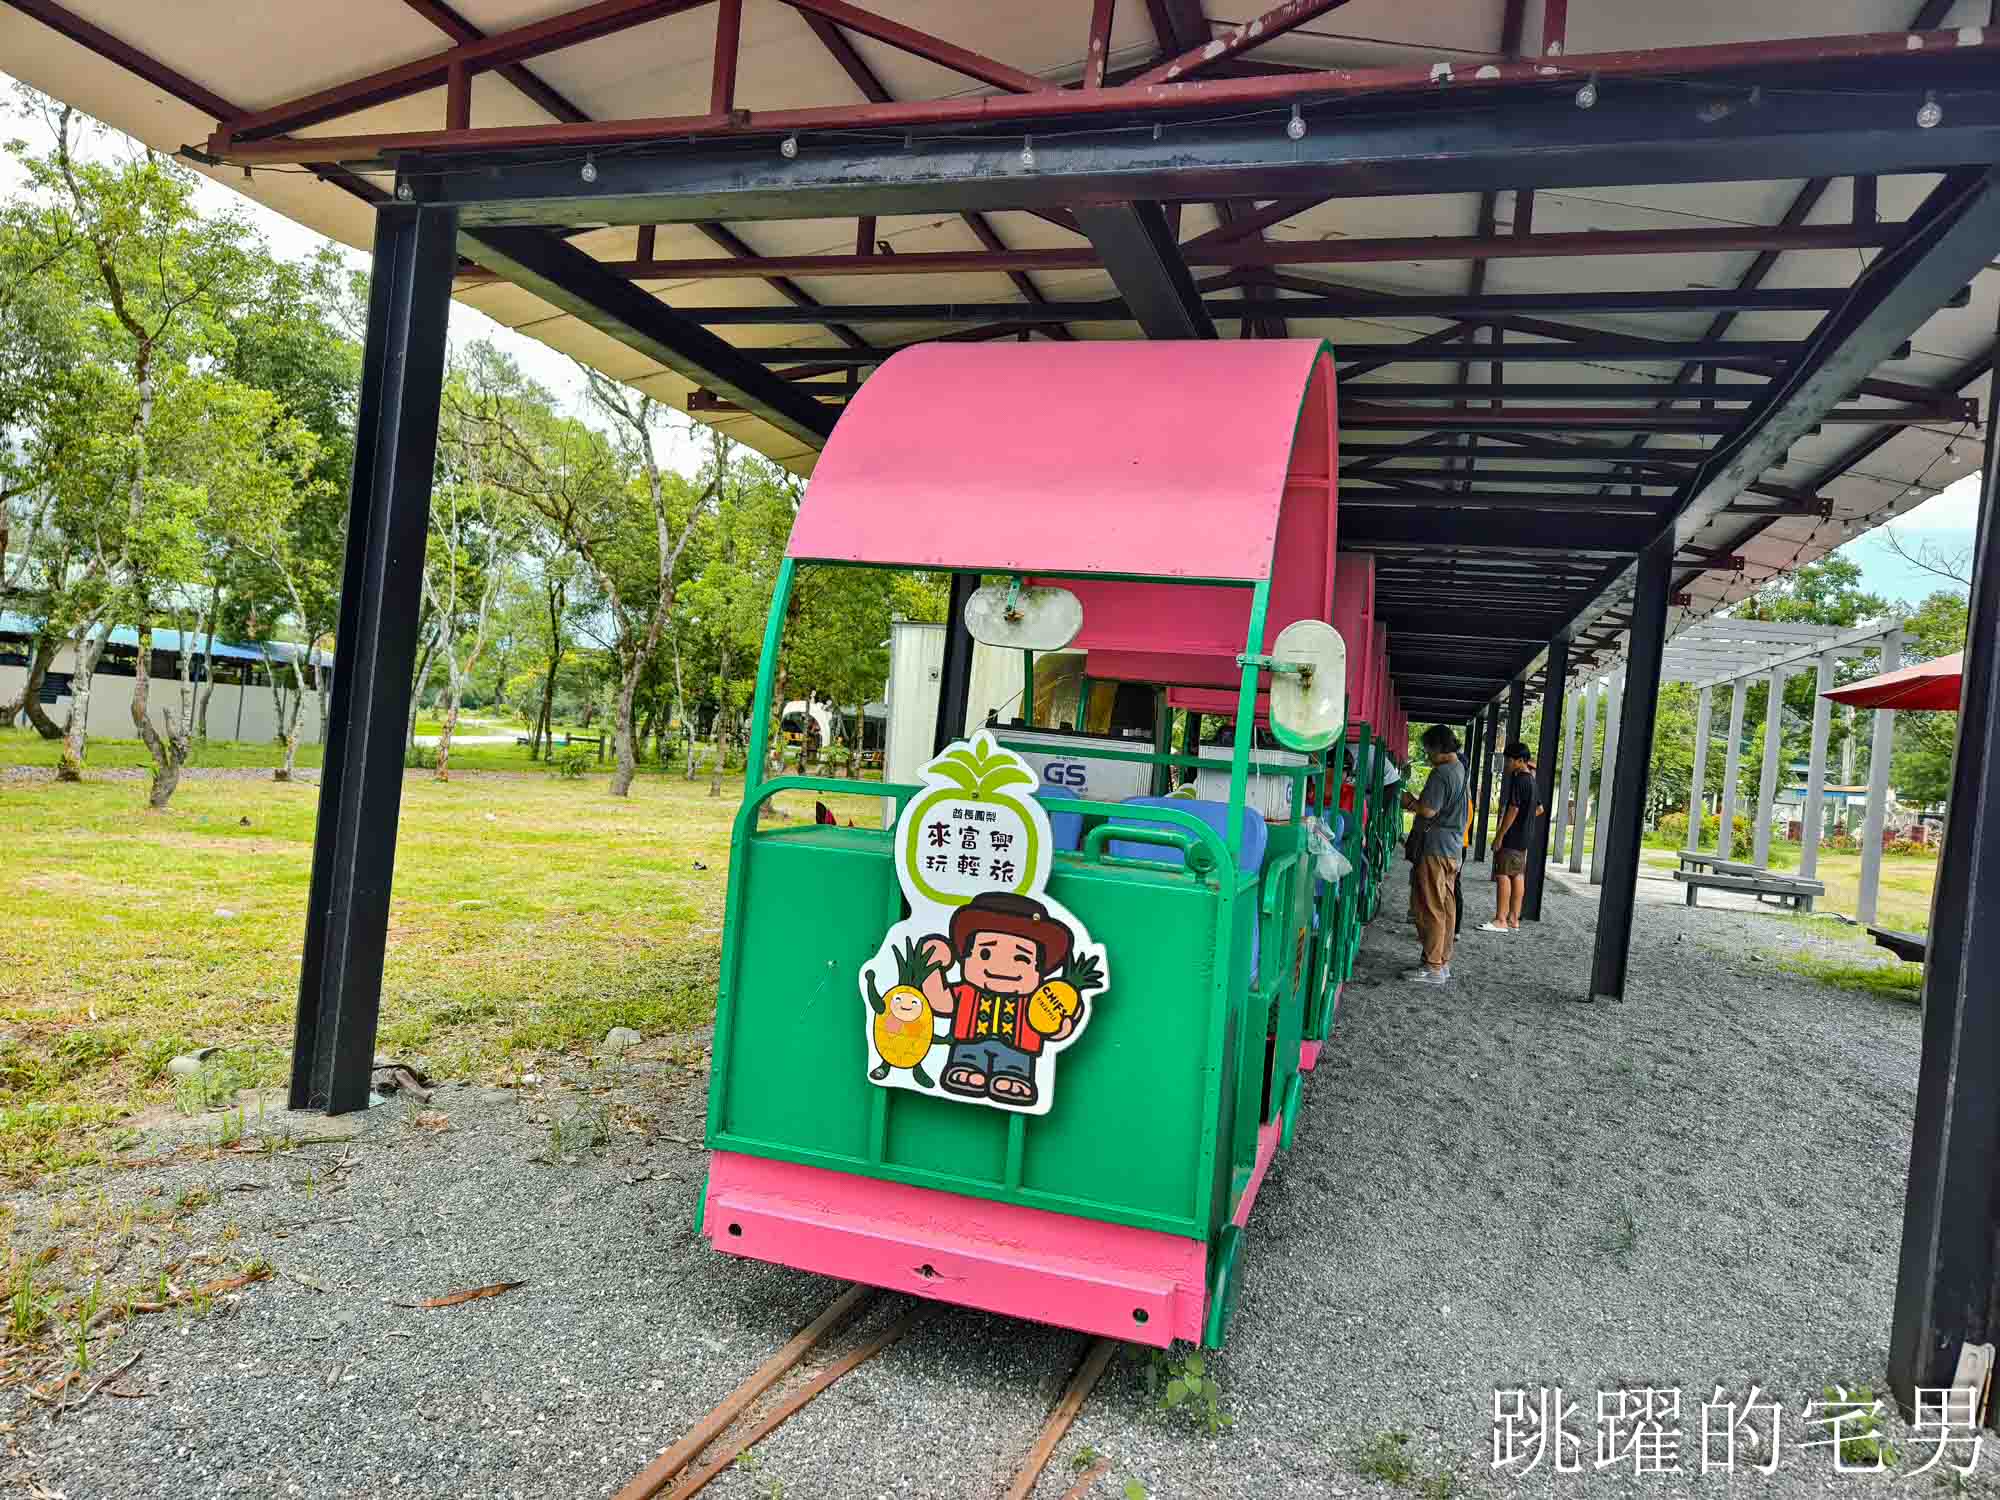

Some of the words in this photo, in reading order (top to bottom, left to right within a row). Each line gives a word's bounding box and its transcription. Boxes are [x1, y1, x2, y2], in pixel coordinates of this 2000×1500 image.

[1043, 762, 1087, 786] GS
[927, 821, 1014, 852] 來富興
[926, 854, 1015, 882] 玩輕旅
